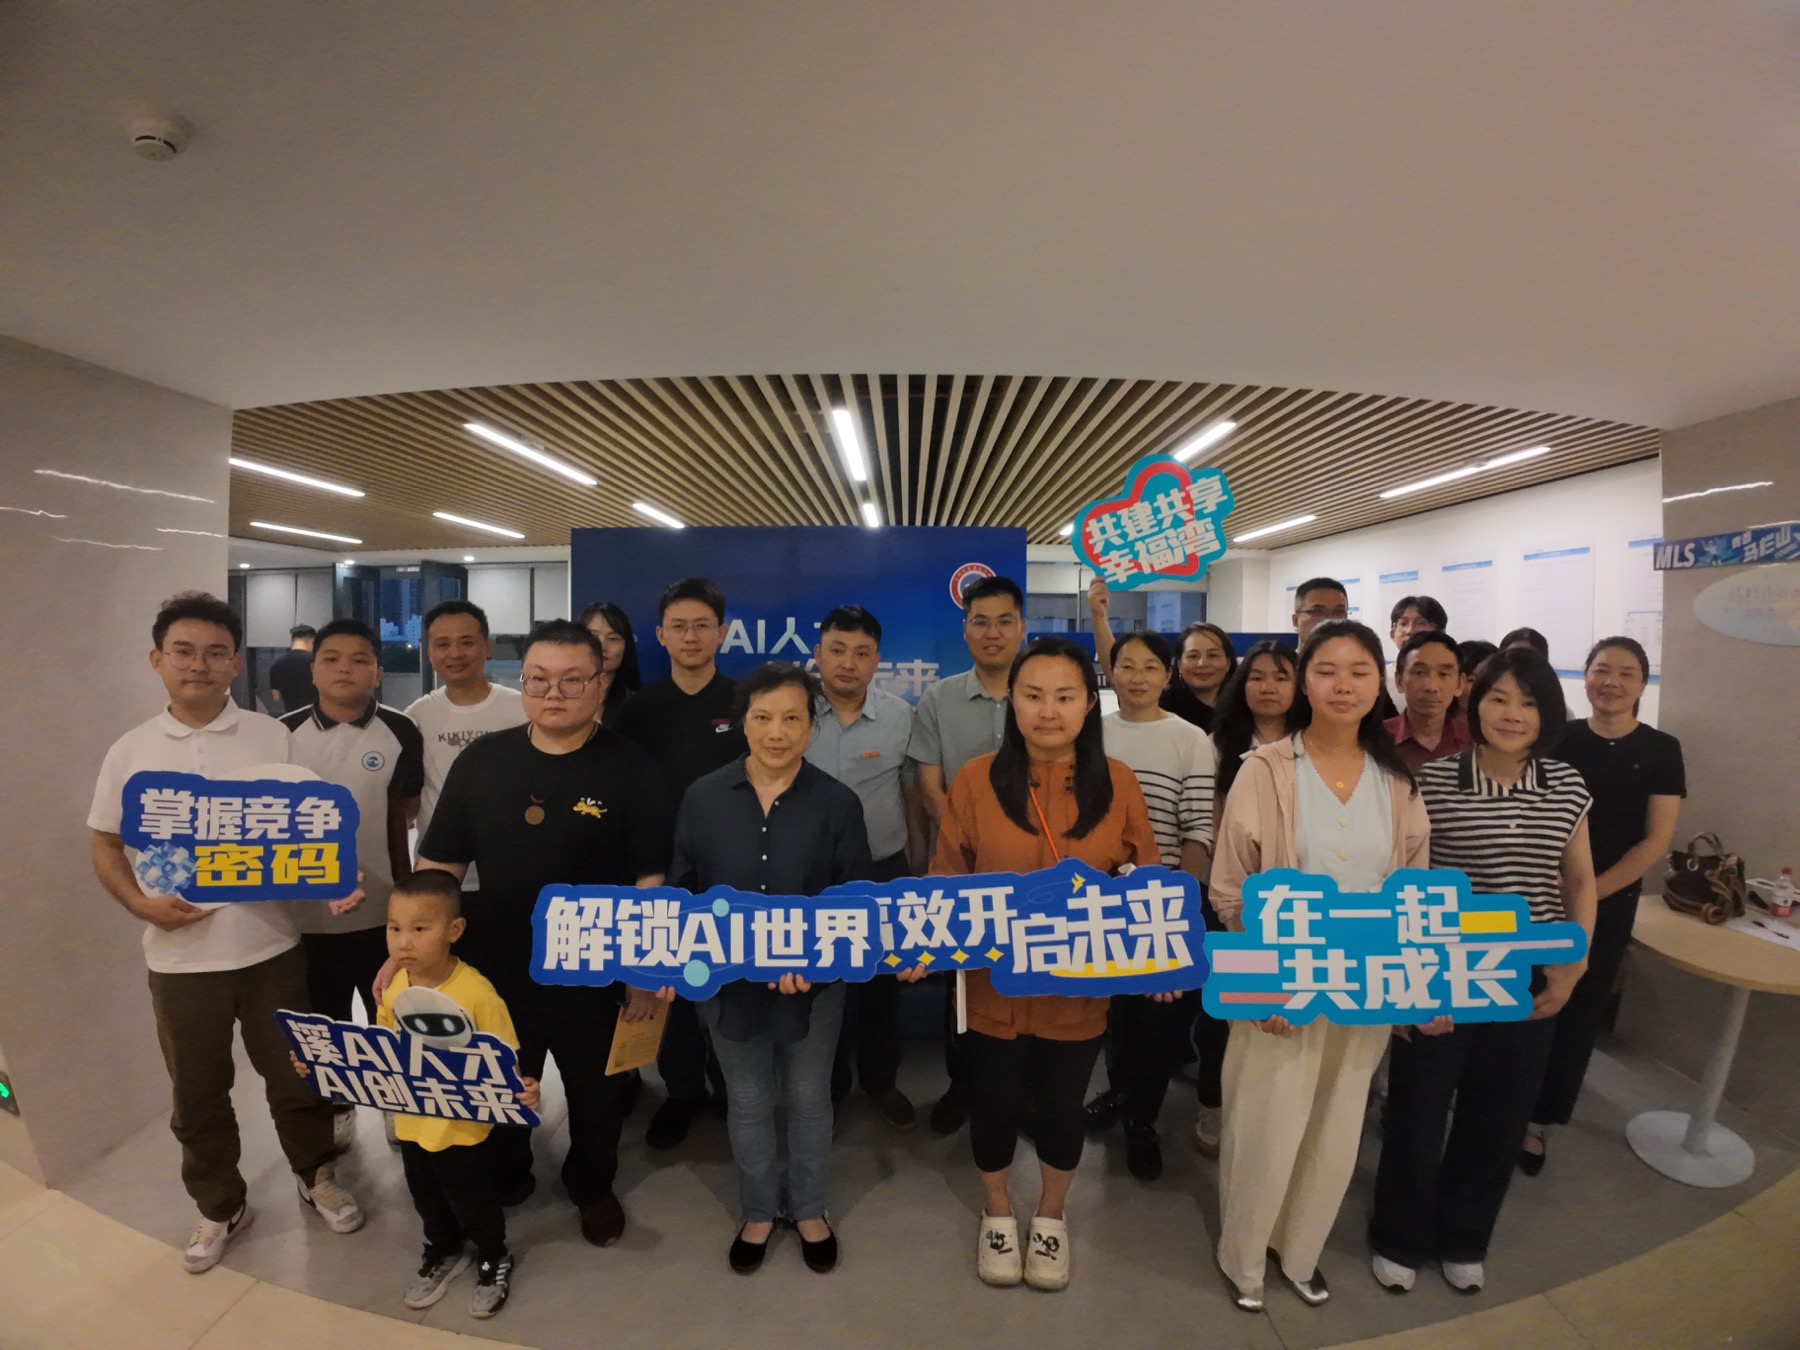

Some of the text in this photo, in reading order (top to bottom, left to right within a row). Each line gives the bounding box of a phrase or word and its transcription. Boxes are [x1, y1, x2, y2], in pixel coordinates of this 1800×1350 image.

[1085, 475, 1228, 554] 共建共享
[1099, 517, 1222, 583] 幸福湾
[1656, 543, 1695, 569] MLS
[138, 788, 342, 840] 掌握竞争
[194, 843, 340, 886] 密码
[543, 896, 871, 971] 解锁AI世界
[1257, 884, 1462, 945] 在一起
[1282, 945, 1520, 1010] 共成长
[314, 1065, 529, 1125] AI创未来
